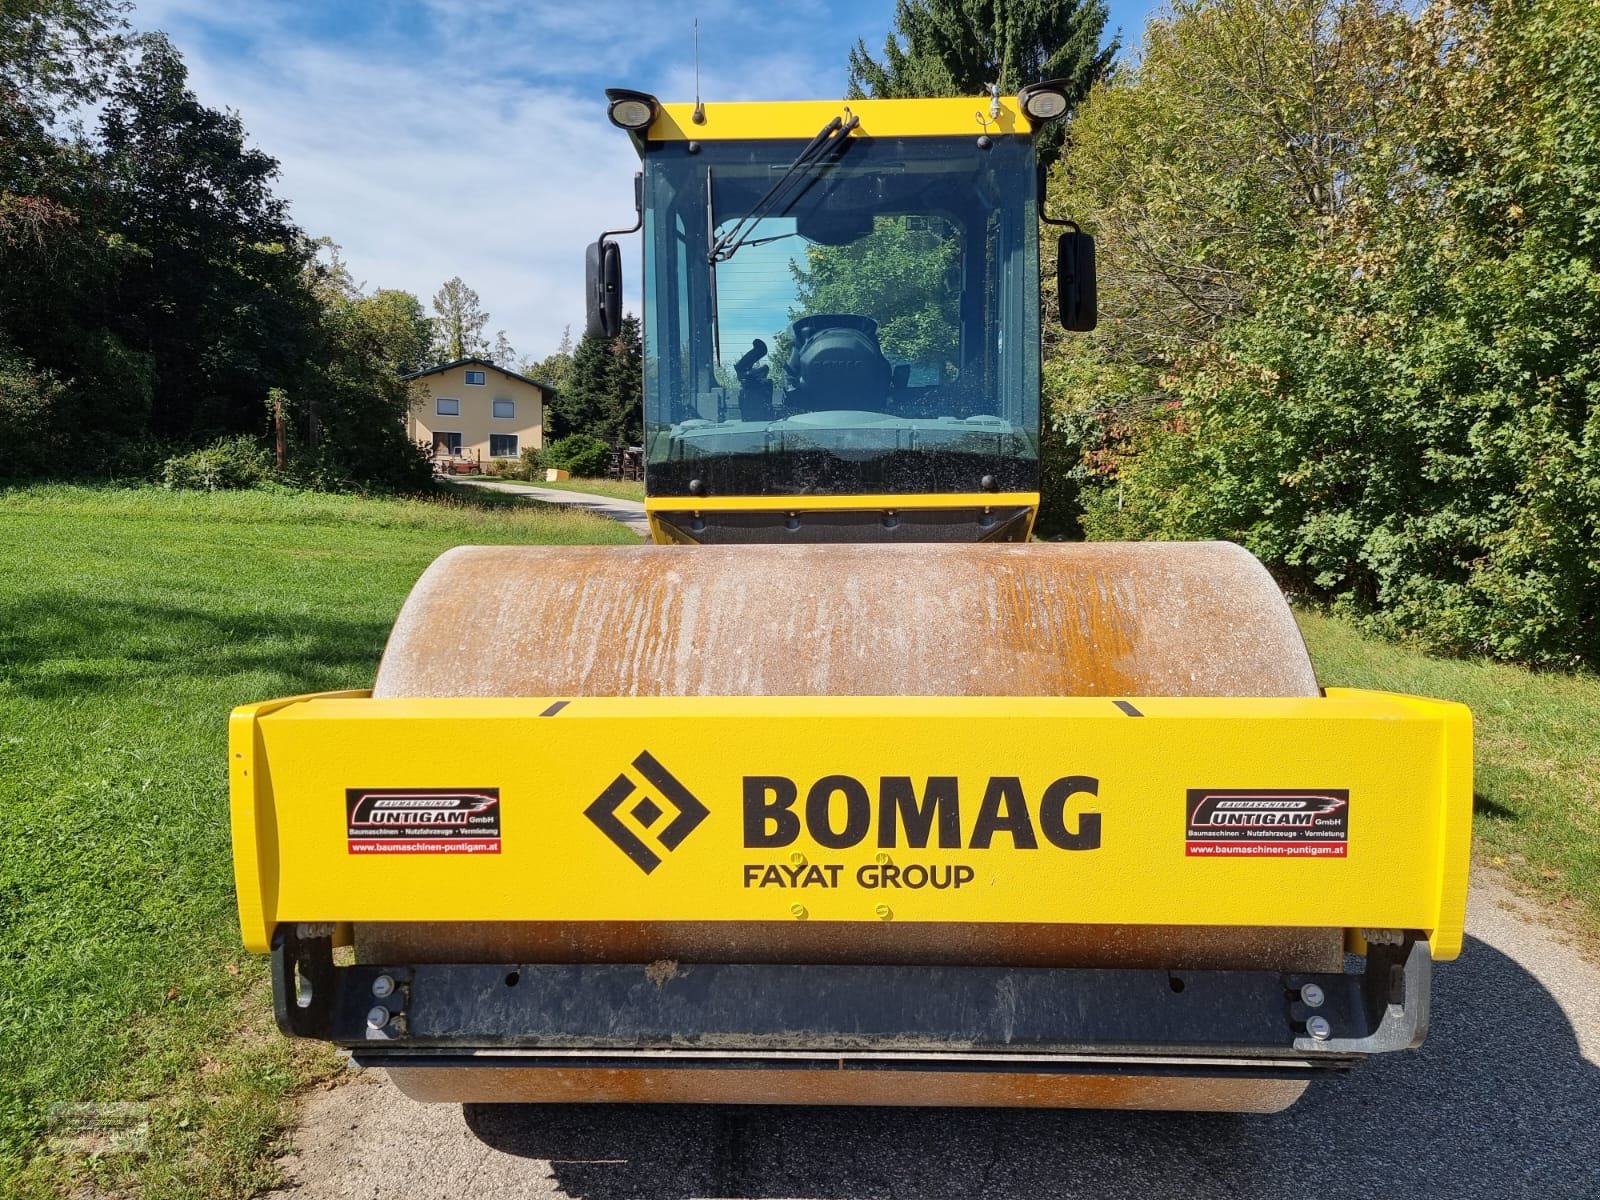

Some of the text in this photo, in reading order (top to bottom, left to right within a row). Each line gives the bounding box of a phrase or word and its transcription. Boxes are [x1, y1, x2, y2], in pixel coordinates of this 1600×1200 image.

[742, 774, 1101, 851] BOMAG
[469, 816, 494, 824] GmbH
[1315, 818, 1341, 826] GmbH
[405, 828, 453, 836] Nutzfahrzeuge
[460, 828, 498, 836] Vermietung
[1247, 830, 1297, 838] Nutzfahrzeuge
[1305, 830, 1345, 838] Vermietung
[352, 842, 498, 853] www.baumaschinen-puntigam.at
[1190, 845, 1344, 856] www.baumaschinen-puntigam.at
[743, 863, 975, 890] FAYAT GROUP
